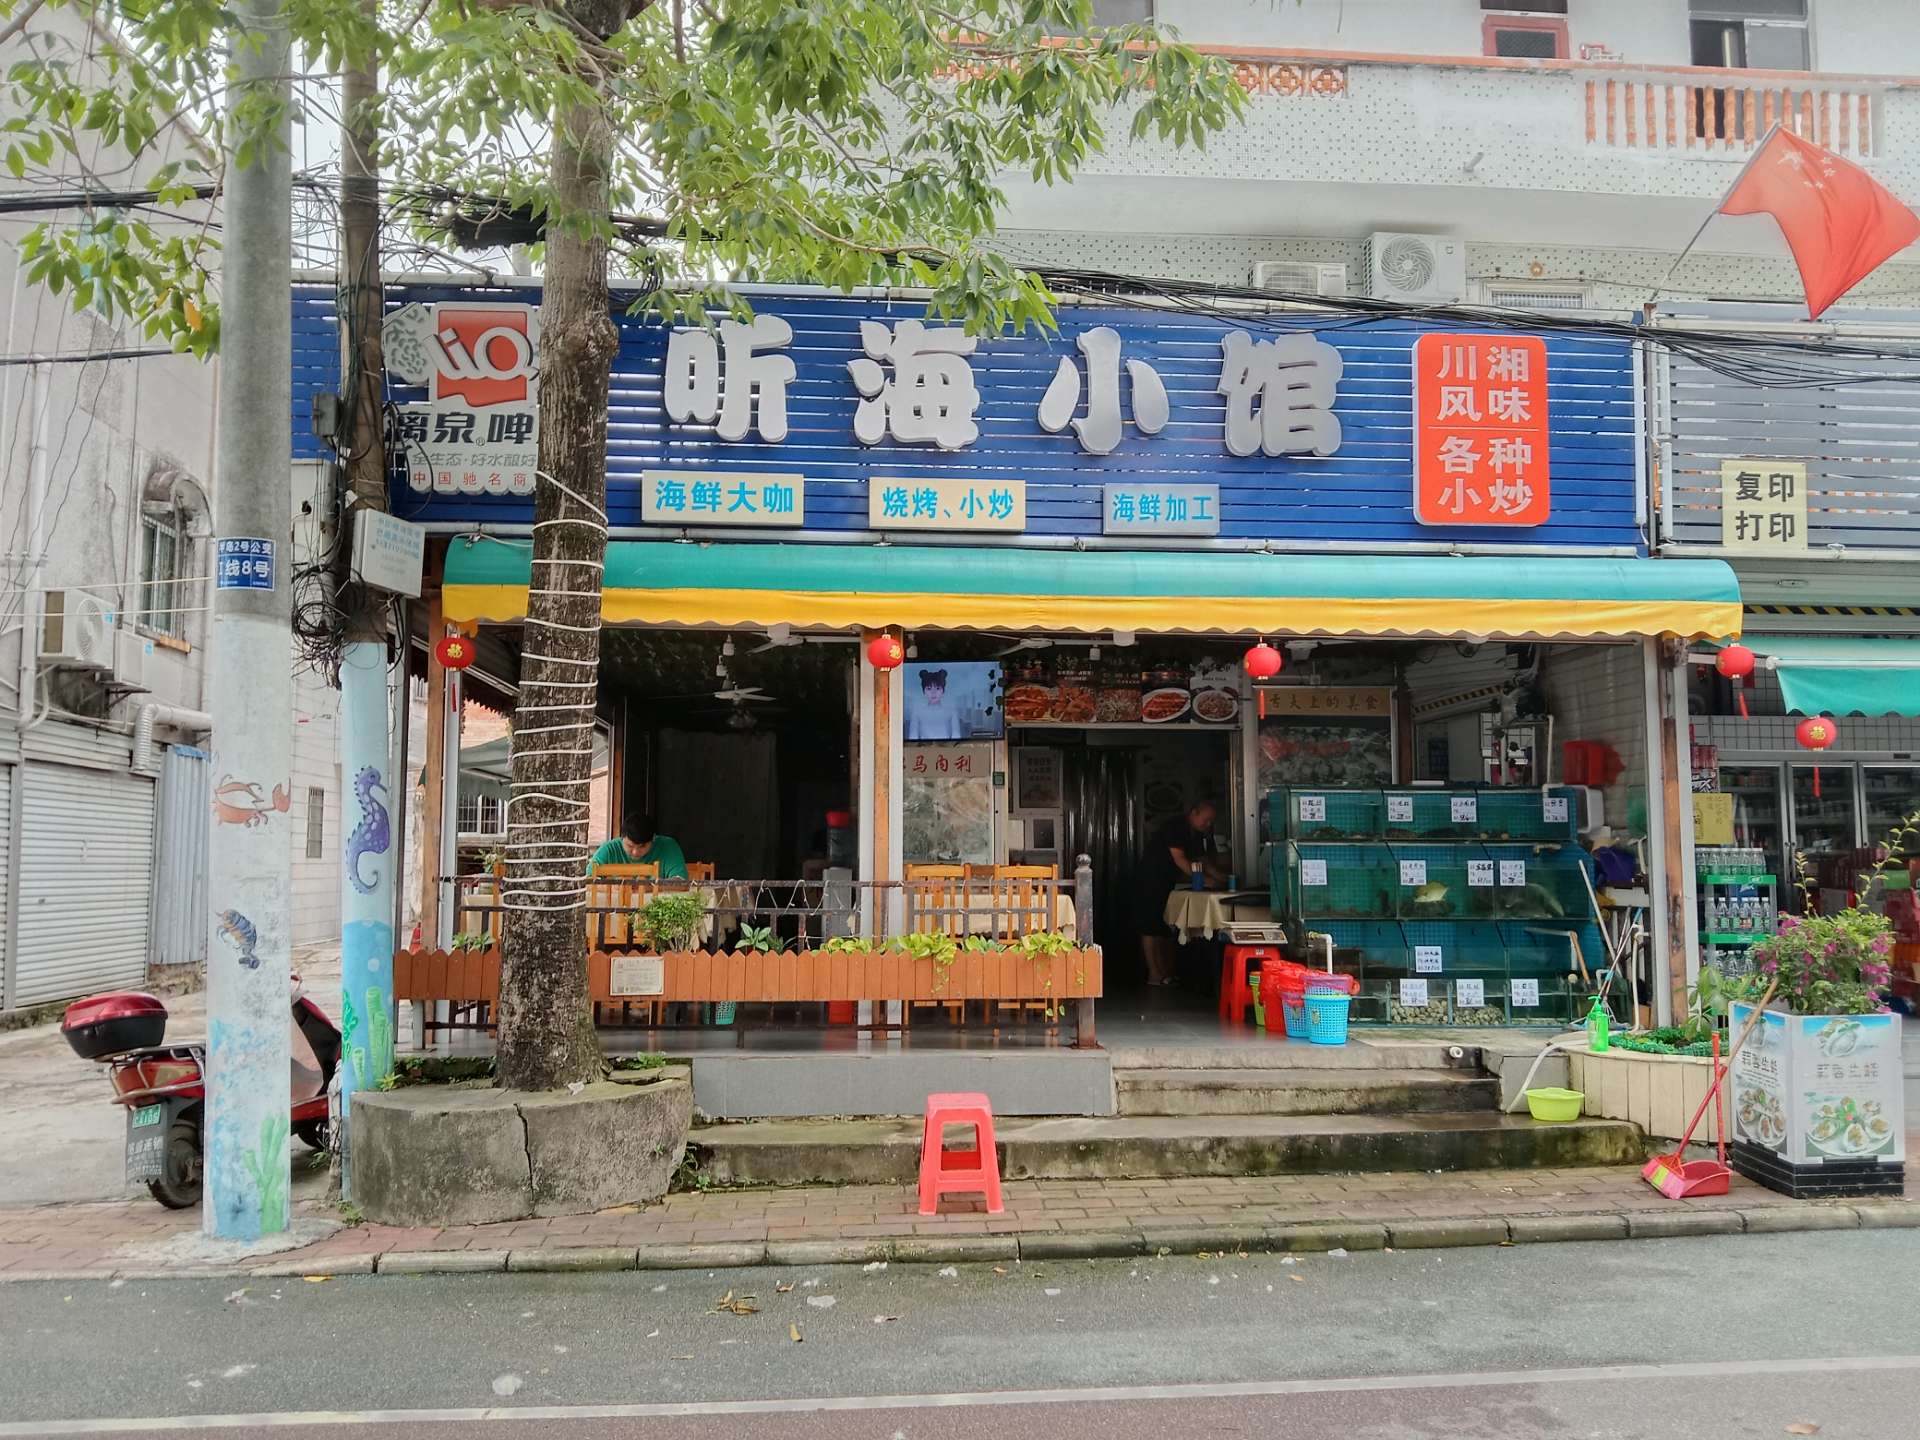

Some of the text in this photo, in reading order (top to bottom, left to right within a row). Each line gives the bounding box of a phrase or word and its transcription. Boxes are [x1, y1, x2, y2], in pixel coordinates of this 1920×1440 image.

[1436, 345, 1530, 382] 川湘
[1437, 387, 1532, 423] 风味
[1437, 436, 1532, 475] 各种
[655, 480, 794, 514] 海鲜大咖
[882, 486, 1015, 520] 烧烤、小炒
[1438, 478, 1535, 516] 小炒
[1735, 471, 1795, 502] 复印
[1112, 493, 1214, 522] 海鲜加工
[1735, 511, 1795, 542] 打印
